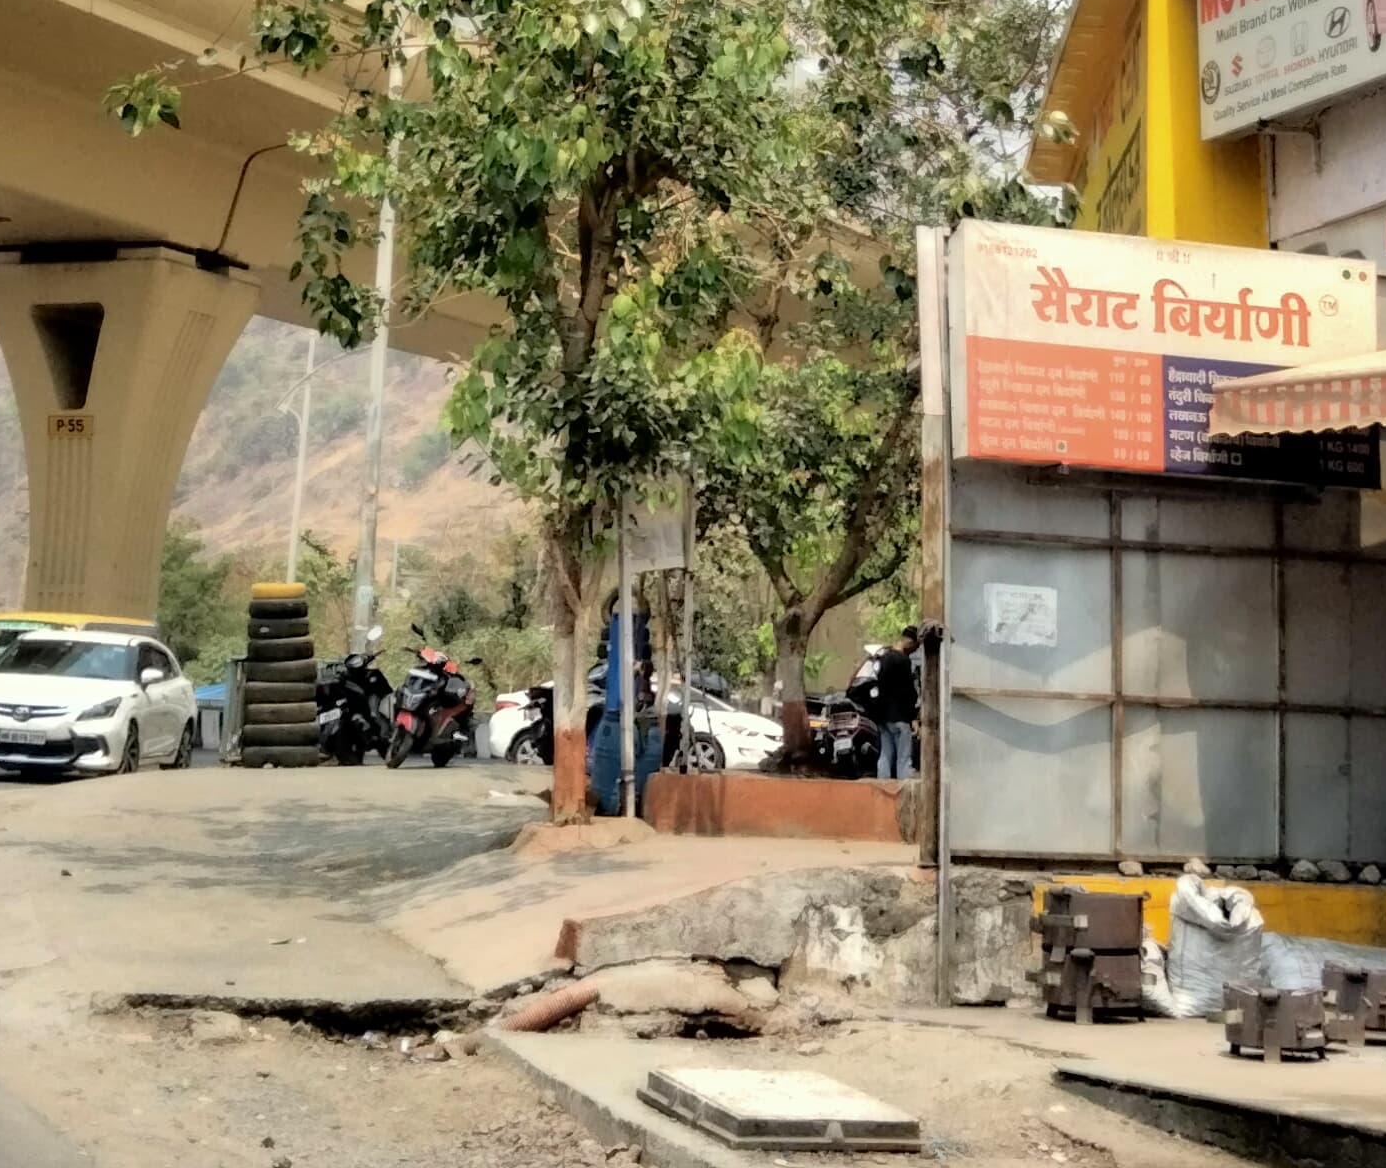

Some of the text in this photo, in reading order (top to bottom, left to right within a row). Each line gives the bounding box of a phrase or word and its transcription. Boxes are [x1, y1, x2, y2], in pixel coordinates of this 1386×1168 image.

[1216, 20, 1237, 42] Multi
[1239, 12, 1267, 34] Brand
[1269, 5, 1285, 21] Car
[1030, 266, 1311, 347] सैराट बिर्याणी
[1327, 441, 1344, 453] KG
[1327, 461, 1344, 472] KG
